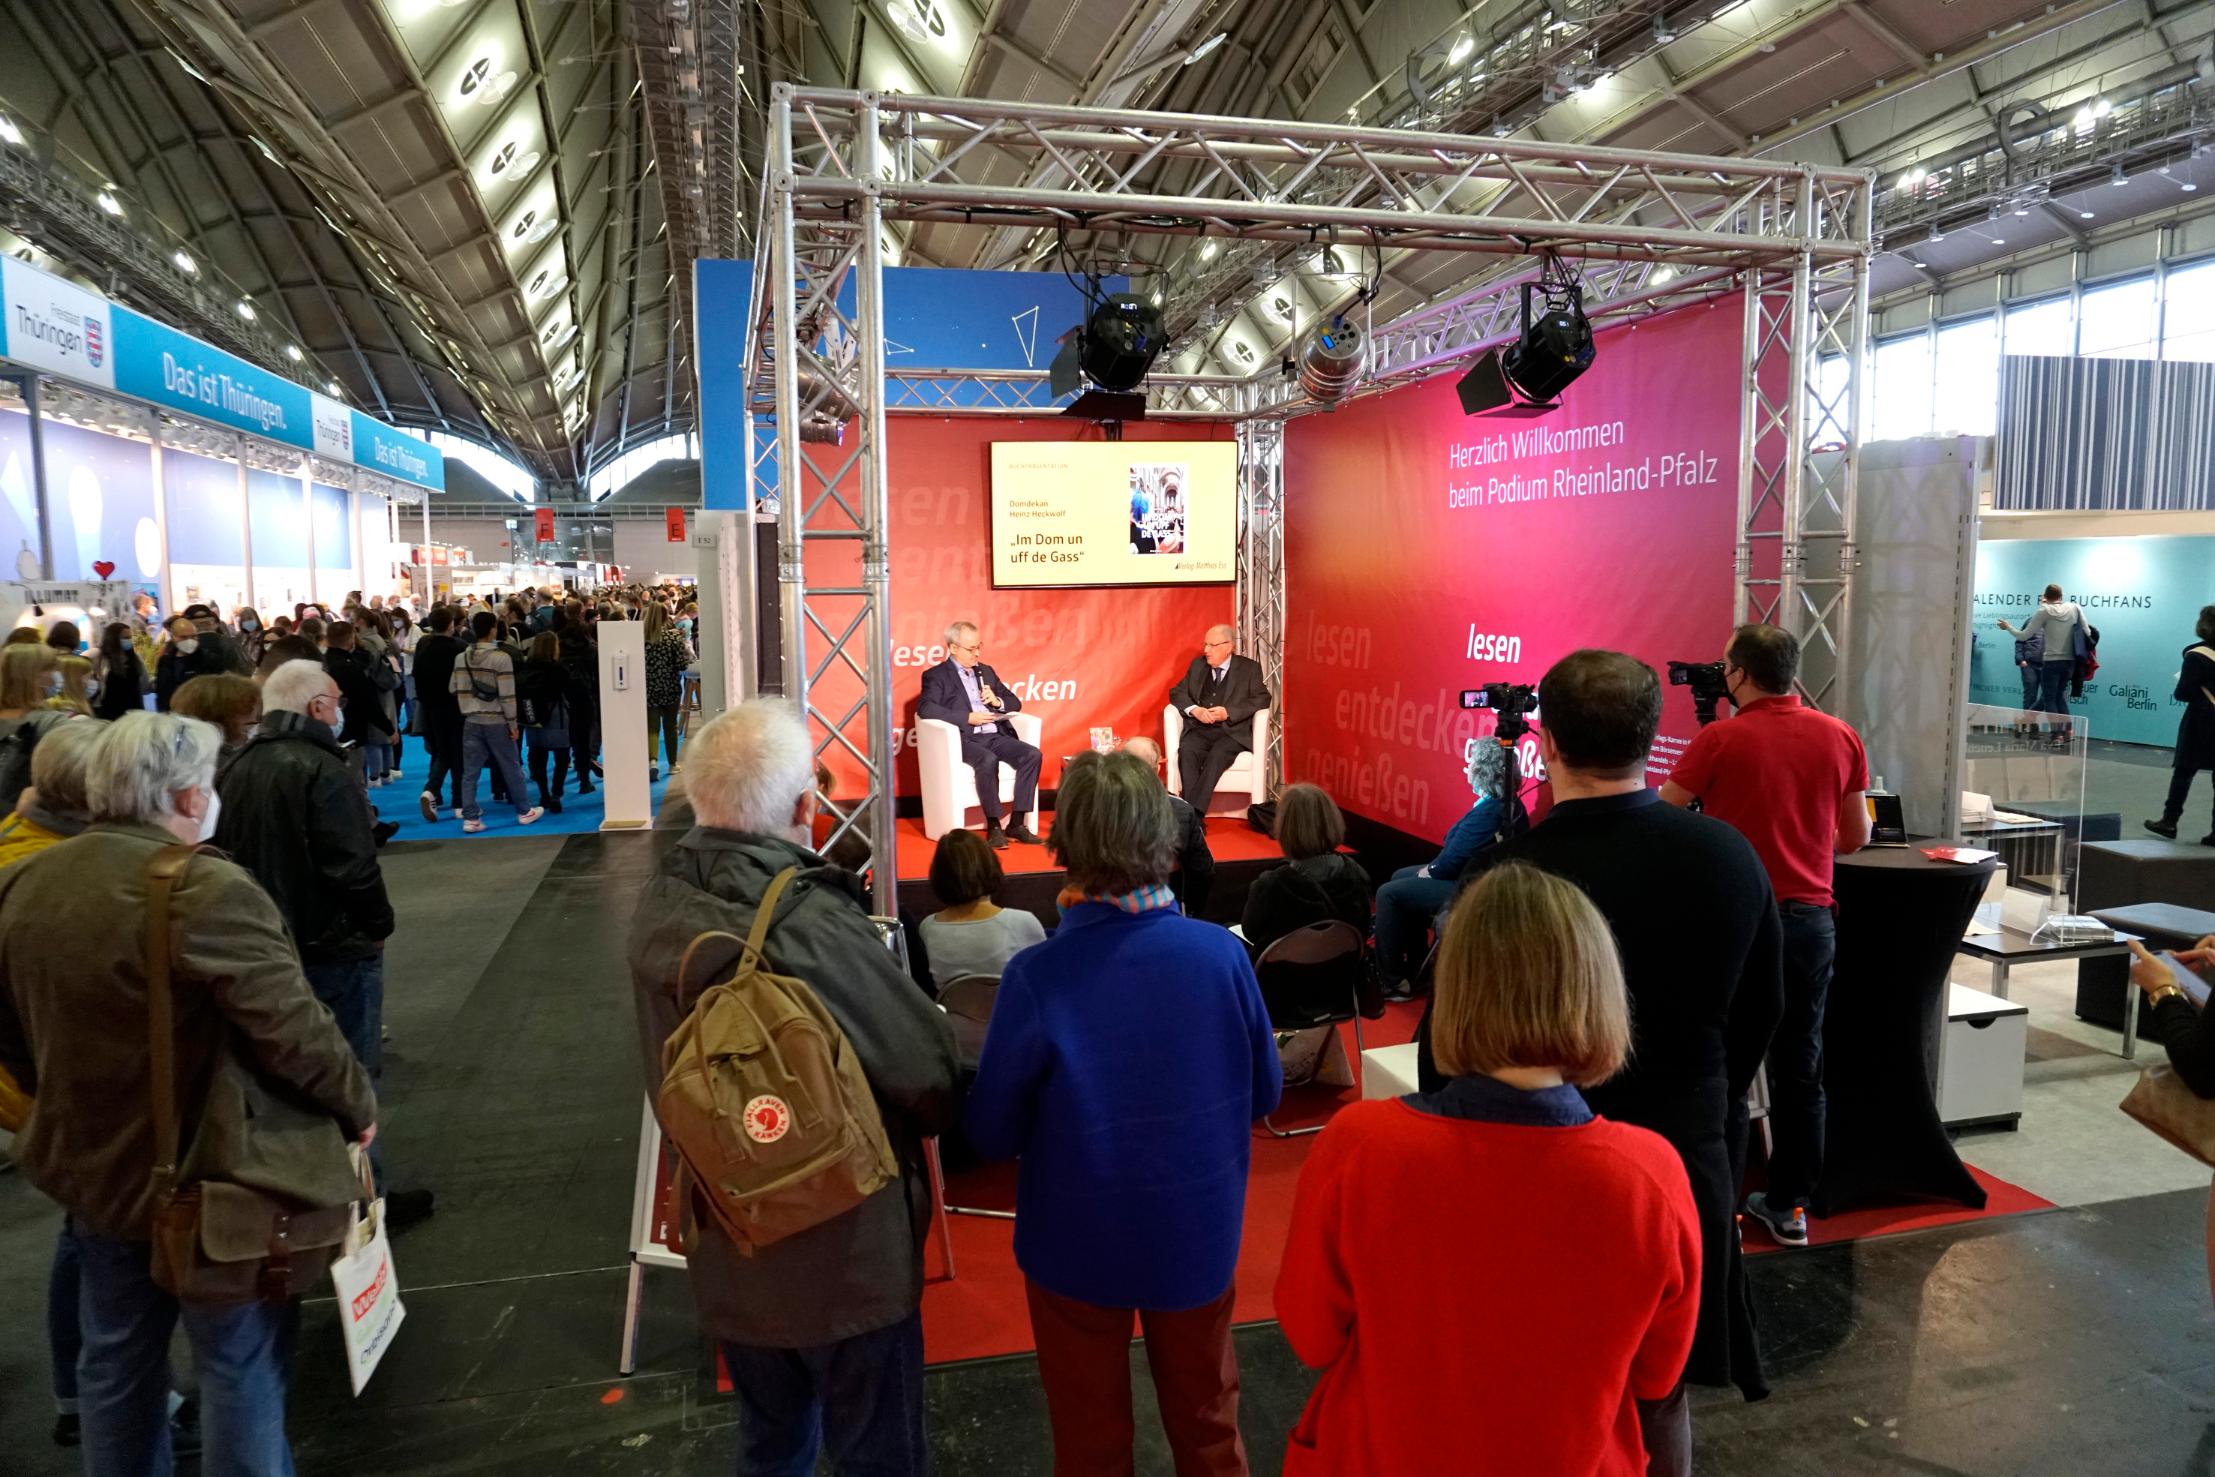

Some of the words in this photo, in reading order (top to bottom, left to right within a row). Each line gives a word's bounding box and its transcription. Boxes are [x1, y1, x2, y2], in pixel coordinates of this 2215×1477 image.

[16, 303, 83, 356] Thüringen
[163, 351, 196, 398] Das
[198, 364, 219, 407] ist
[219, 373, 287, 431] Thüringen.
[1450, 434, 1508, 469] Herzlich
[1512, 421, 1624, 460] Willkommen
[1449, 483, 1483, 509] beim
[1488, 475, 1548, 505] Podium
[1553, 450, 1718, 498] Rheinland-Pfalz
[1009, 499, 1049, 507] Domdekan
[1032, 510, 1066, 518] Heckwolf
[541, 523, 550, 537] F
[671, 523, 681, 538] E
[1036, 533, 1064, 545] Dom
[1067, 536, 1083, 545] un
[1010, 551, 1028, 563] uff
[1032, 551, 1047, 562] de
[1974, 593, 2031, 606] ALENDER
[2070, 594, 2153, 609] BUCHFANS
[1306, 609, 1371, 670] lesen
[1467, 623, 1521, 664] lesen
[890, 639, 951, 667] ese
[2109, 684, 2149, 698] Galiani
[2127, 697, 2157, 711] Berlin
